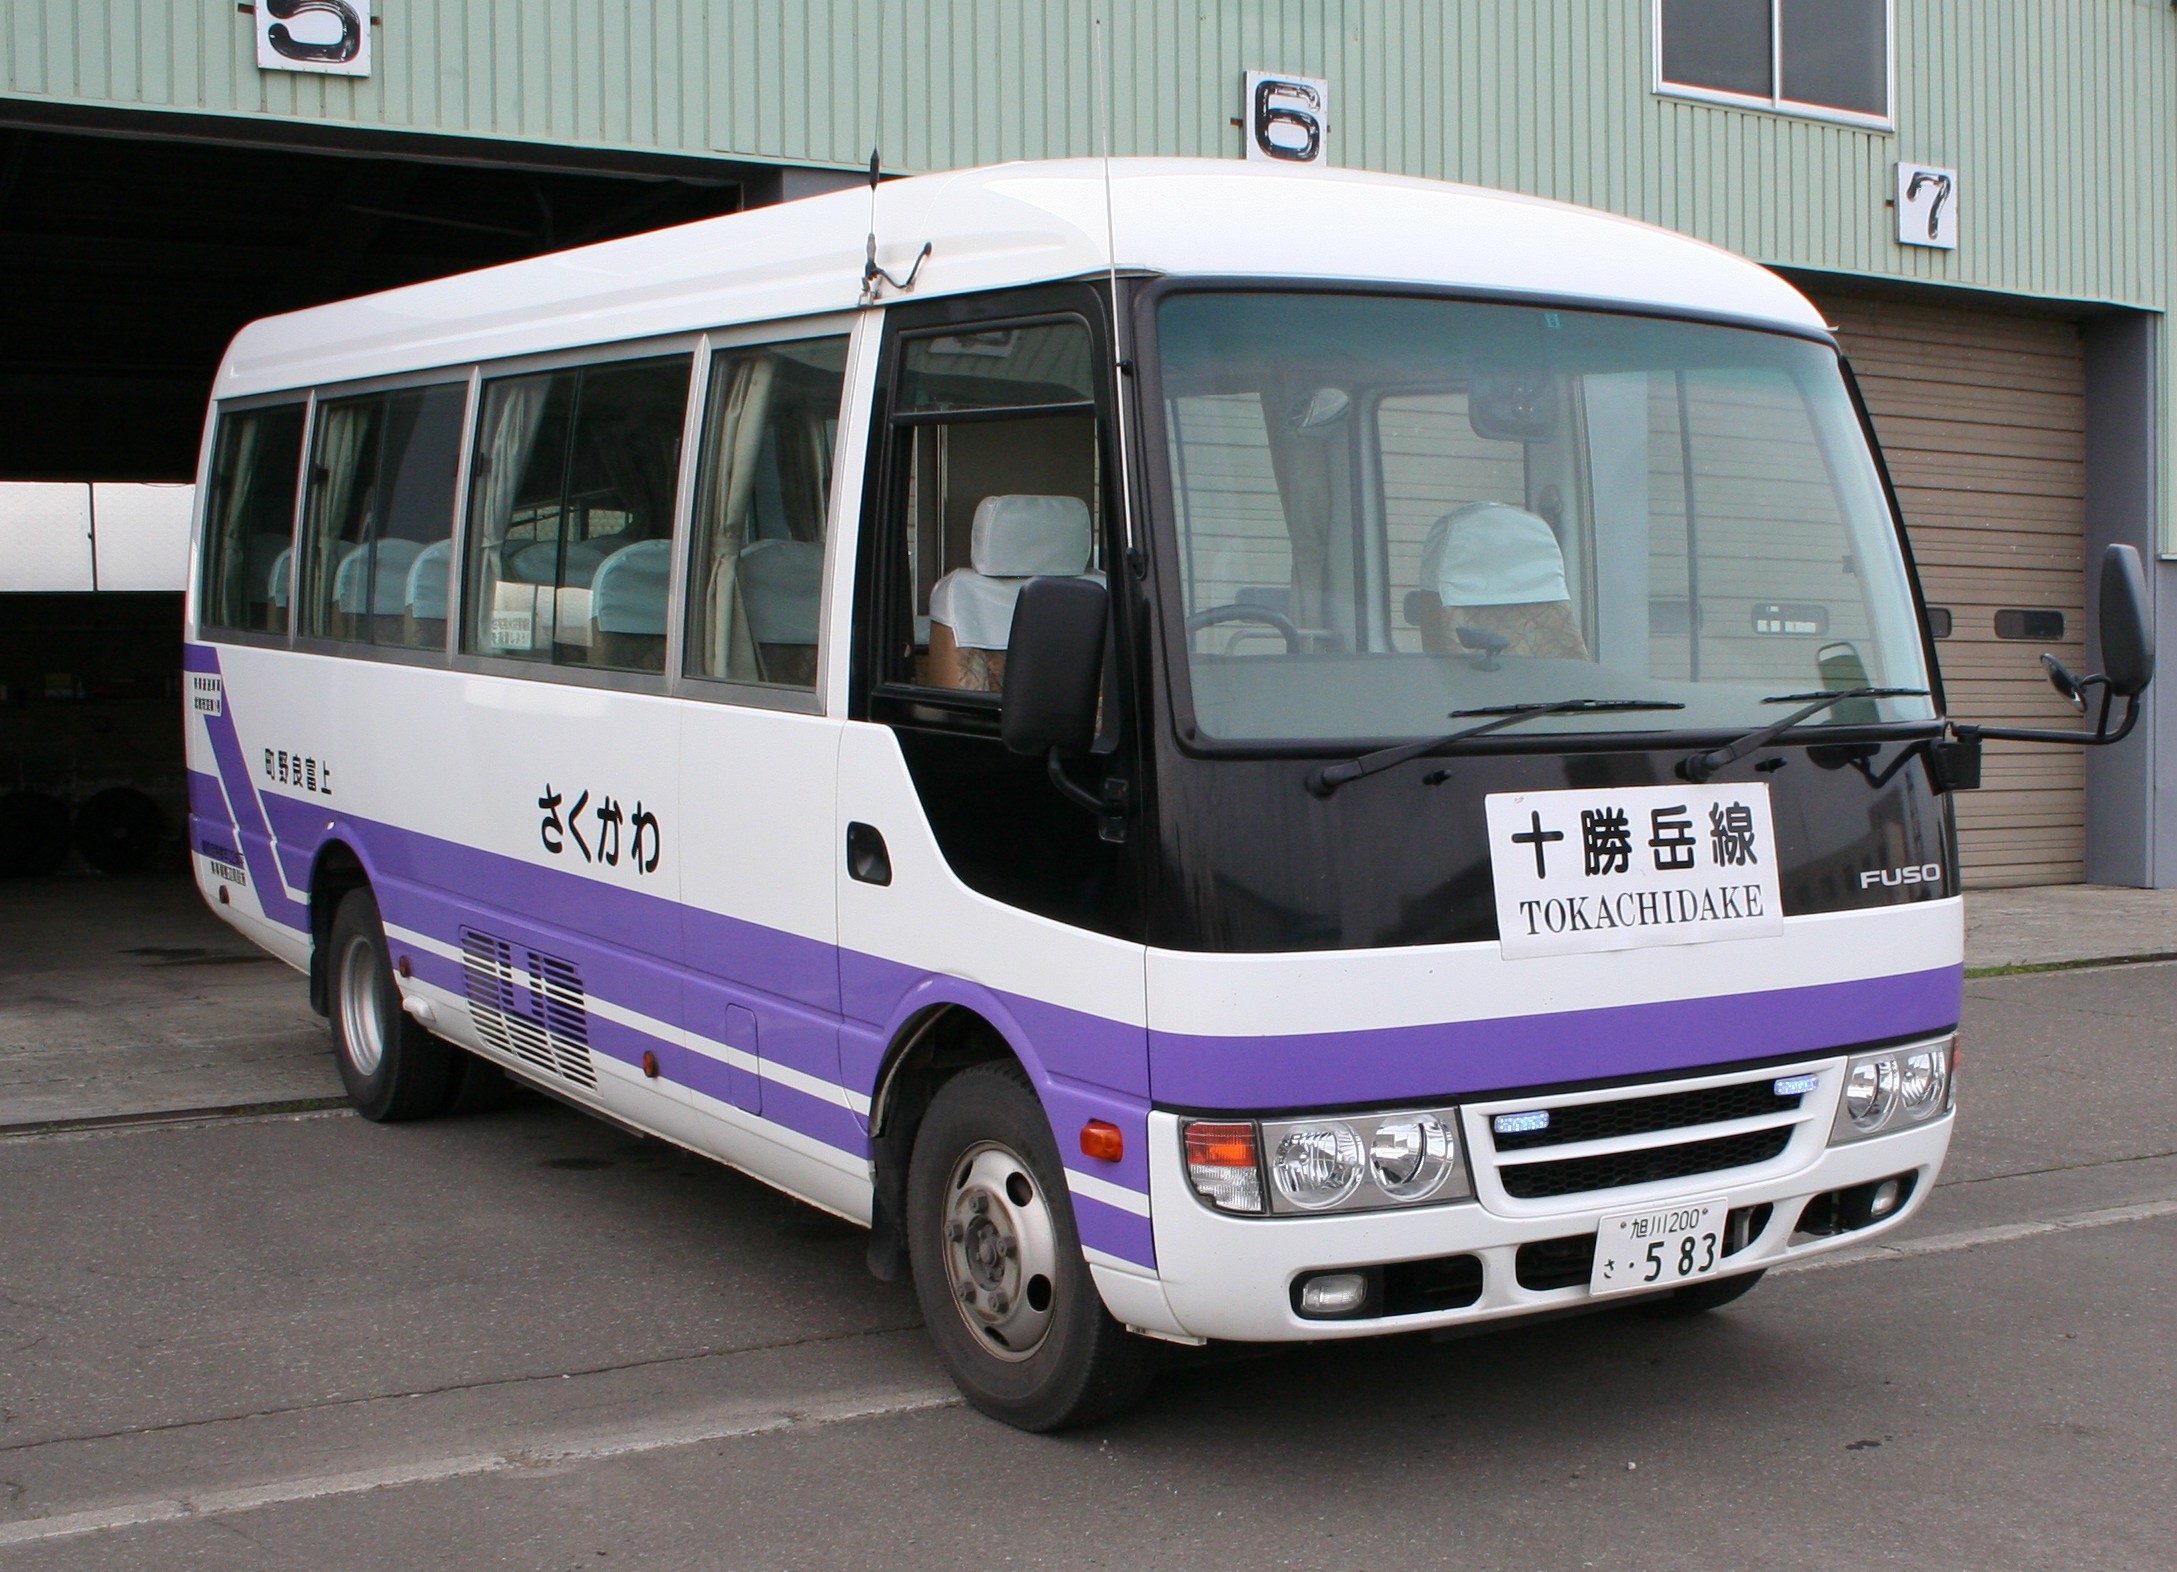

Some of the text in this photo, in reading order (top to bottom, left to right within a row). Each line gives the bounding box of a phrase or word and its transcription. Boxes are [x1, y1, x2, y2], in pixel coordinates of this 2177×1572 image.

[1255, 80, 1321, 163] 6
[1906, 171, 1951, 240] 7
[1512, 801, 1758, 880] 十勝岳線
[1519, 884, 1764, 936] TOKACHIDAKE
[1860, 863, 1942, 890] FUSO
